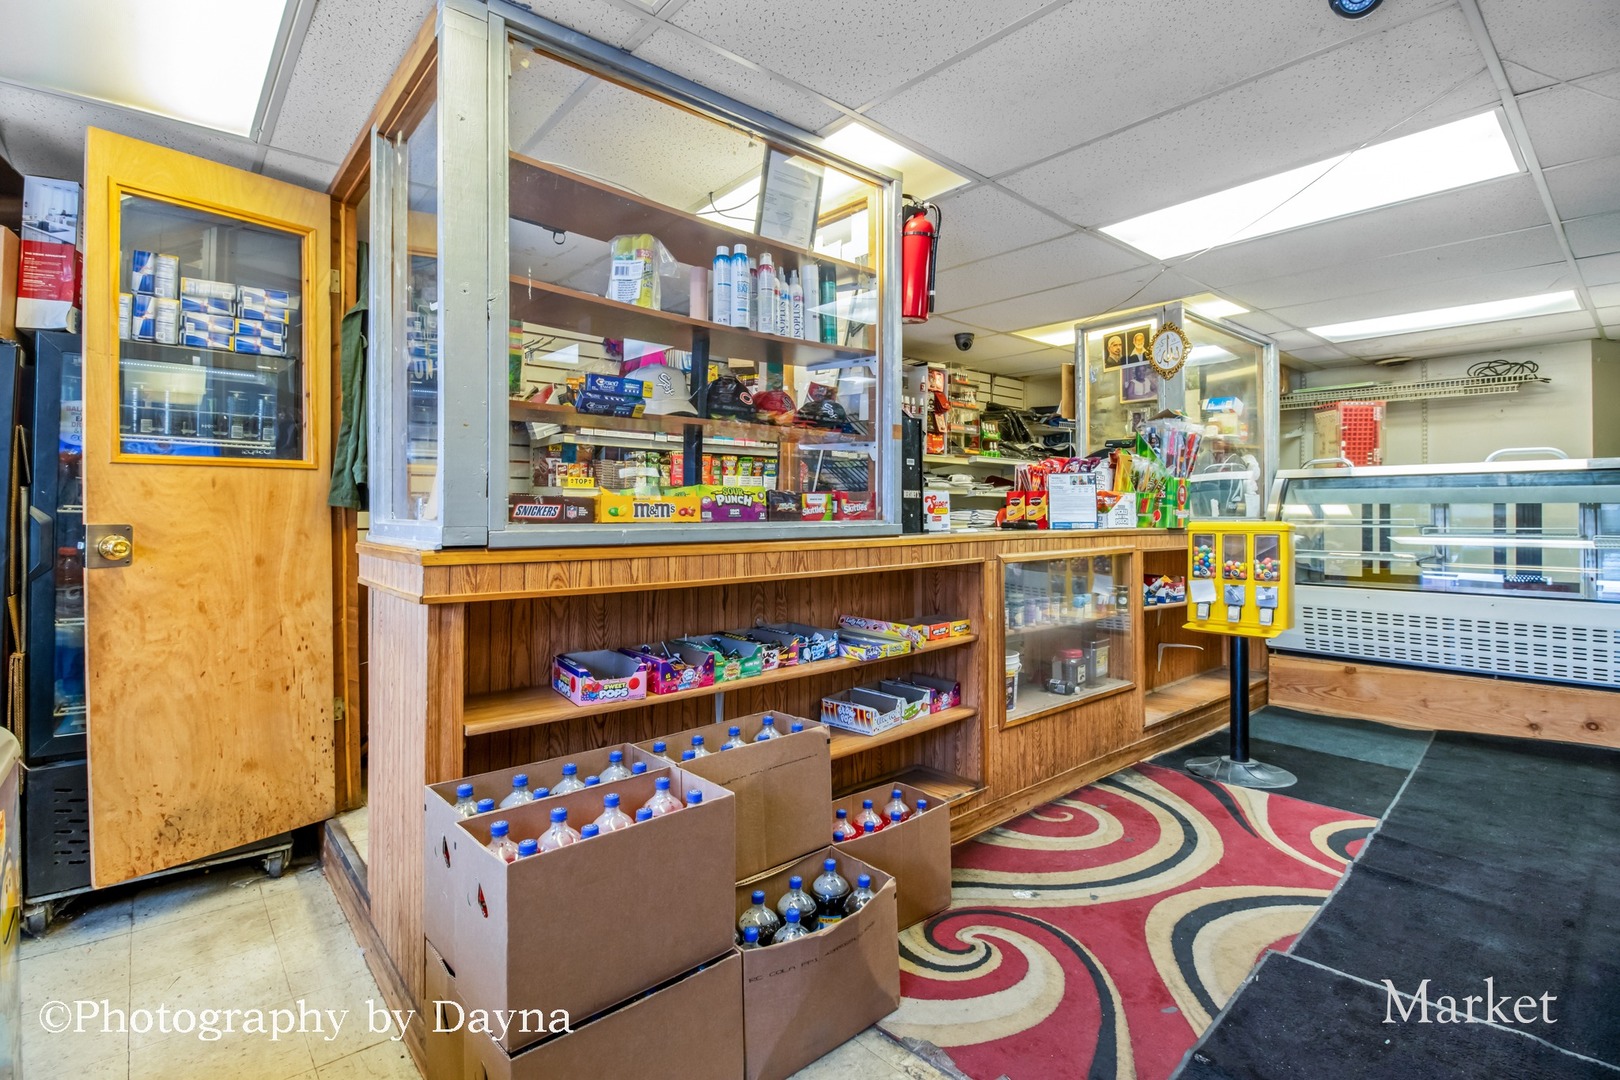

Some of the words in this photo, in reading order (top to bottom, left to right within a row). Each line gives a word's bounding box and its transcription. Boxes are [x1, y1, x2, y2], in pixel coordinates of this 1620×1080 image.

[793, 302, 801, 337] ISOPLUS
[657, 373, 675, 396] Sox
[721, 487, 745, 496] SOUR
[715, 494, 753, 507] PUNCH
[515, 505, 560, 517] SNICKERS
[802, 505, 826, 517] Skittles
[843, 502, 868, 514] Skittles
[603, 682, 627, 690] SWEET
[599, 688, 629, 700] POPS
[838, 705, 856, 717] BLOW
[841, 713, 854, 725] POP
[768, 965, 796, 977] COLA
